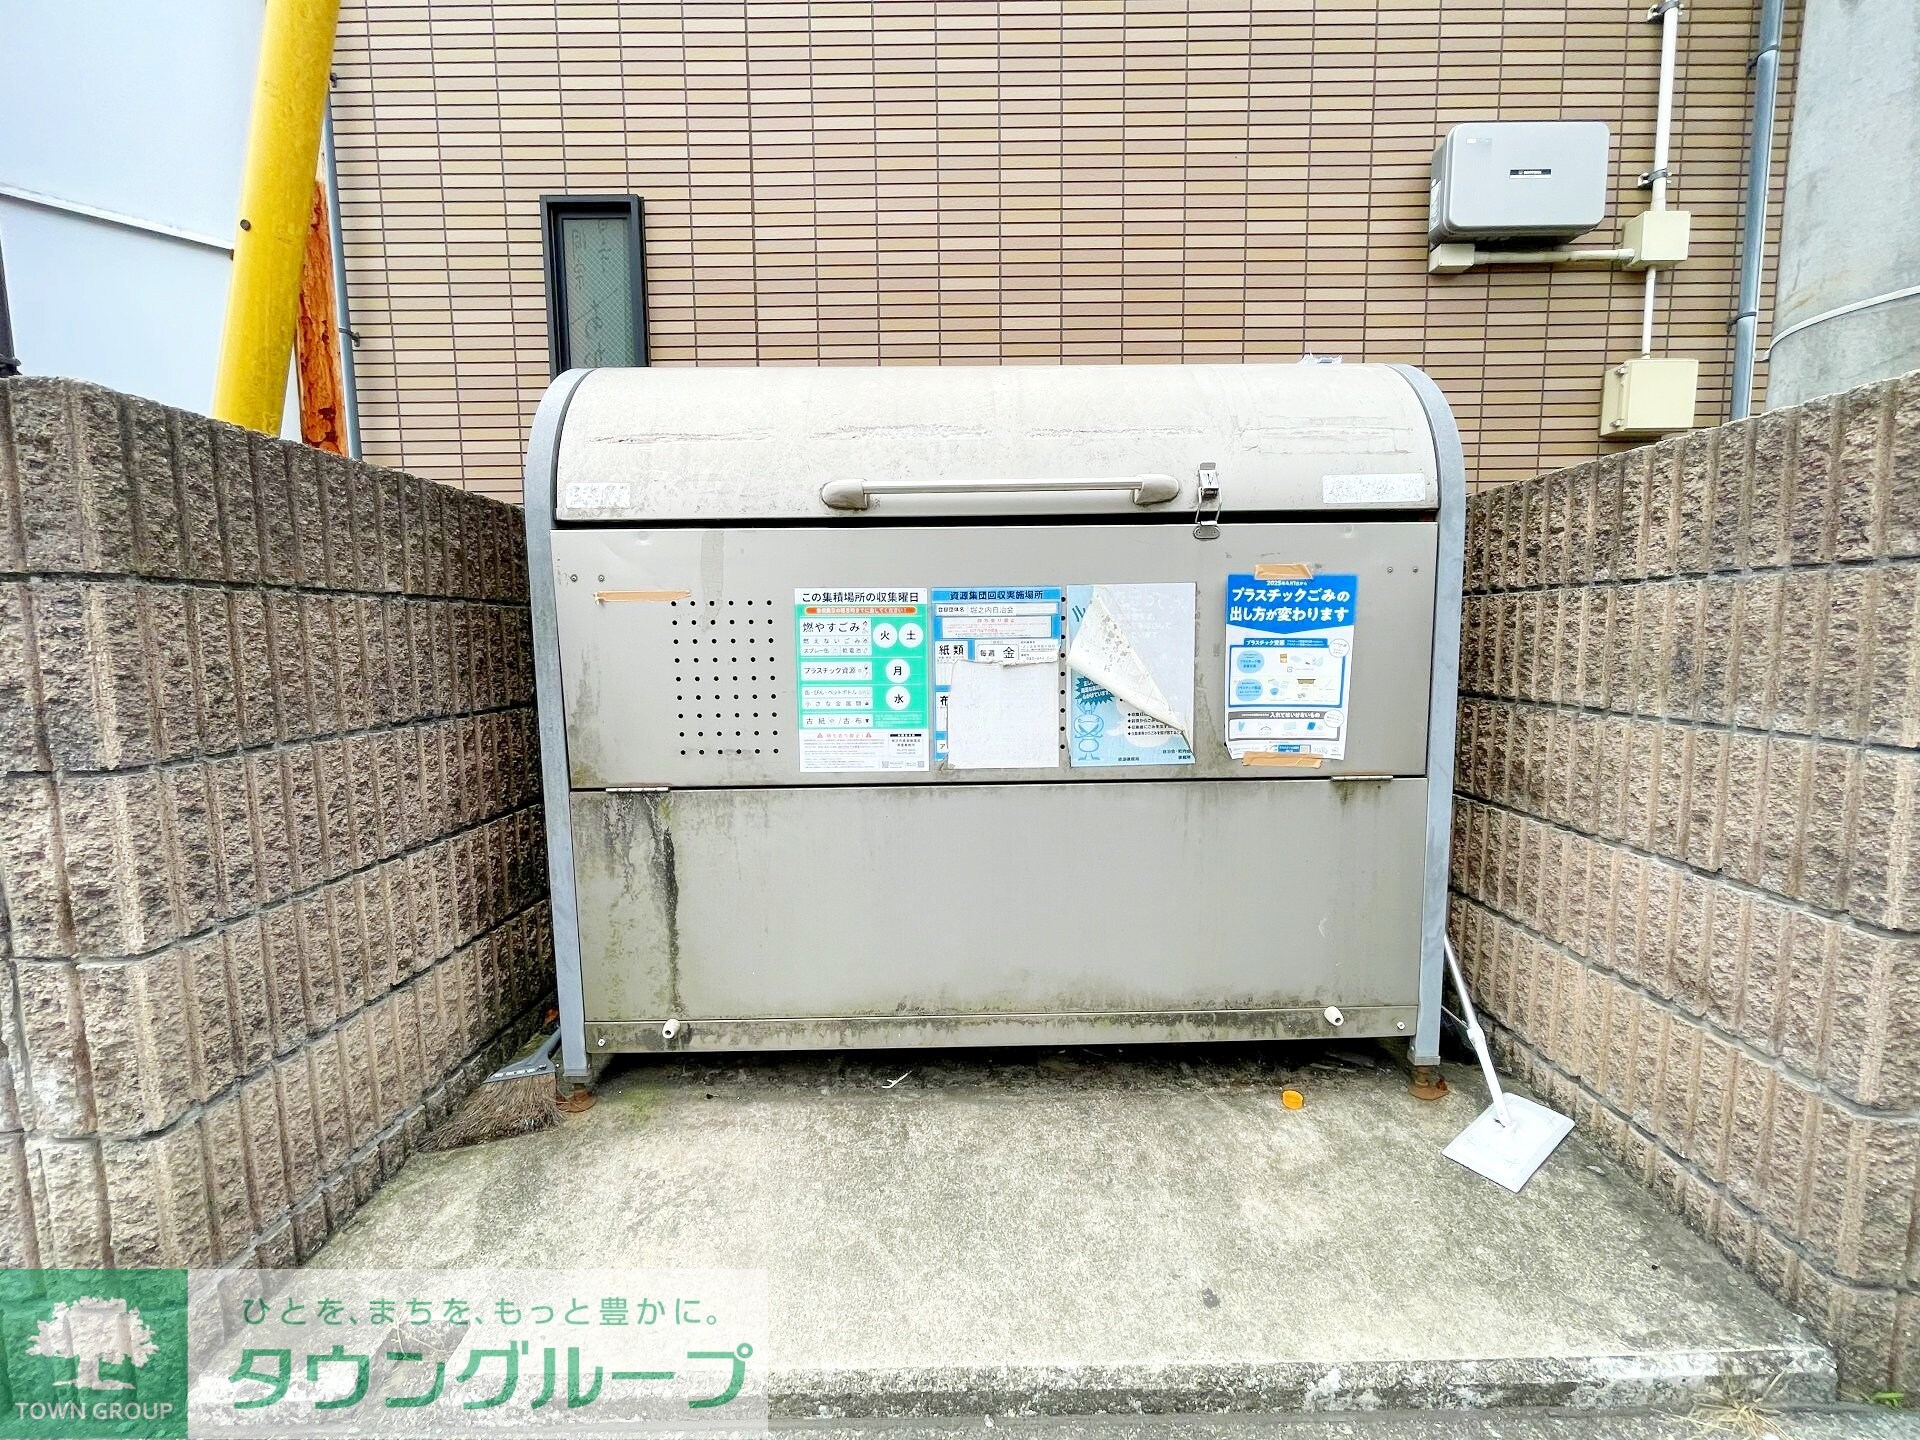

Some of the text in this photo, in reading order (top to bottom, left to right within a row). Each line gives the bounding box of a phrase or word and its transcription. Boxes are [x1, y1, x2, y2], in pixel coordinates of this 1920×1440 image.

[802, 592, 919, 603] この集積場所の収集曜日
[950, 590, 1043, 600] 資源集団回収実施場所
[1231, 586, 1350, 602] プラスチックごみの
[1229, 606, 1350, 622] 出し方が変わります
[802, 622, 860, 633] 燃やすごみ
[880, 630, 890, 641] 火
[906, 630, 916, 641] 土
[939, 645, 964, 656] 紙類
[1002, 646, 1015, 659] 金
[893, 665, 902, 675] 月
[894, 693, 904, 704] 水
